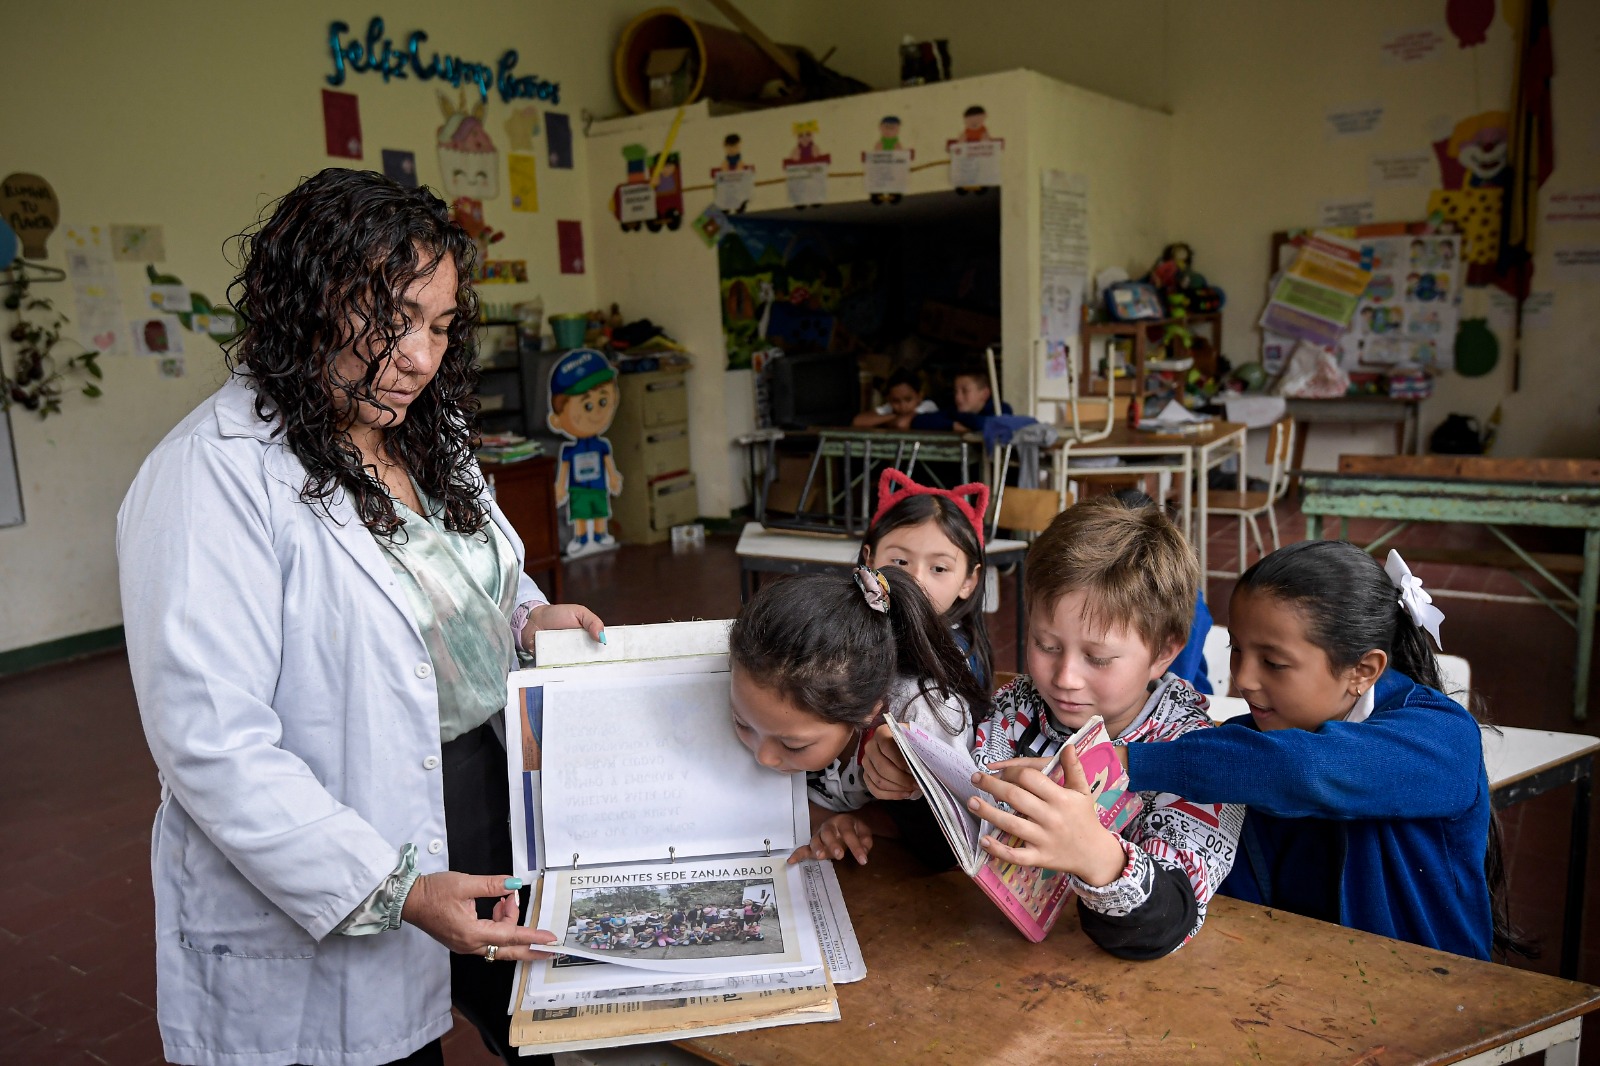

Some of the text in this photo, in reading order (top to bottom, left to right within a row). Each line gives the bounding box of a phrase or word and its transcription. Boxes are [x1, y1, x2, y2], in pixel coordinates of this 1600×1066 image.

[1205, 834, 1233, 863] 2:00
[570, 865, 773, 885] ESTUDIANTES SEDE ZANJA ABAJO
